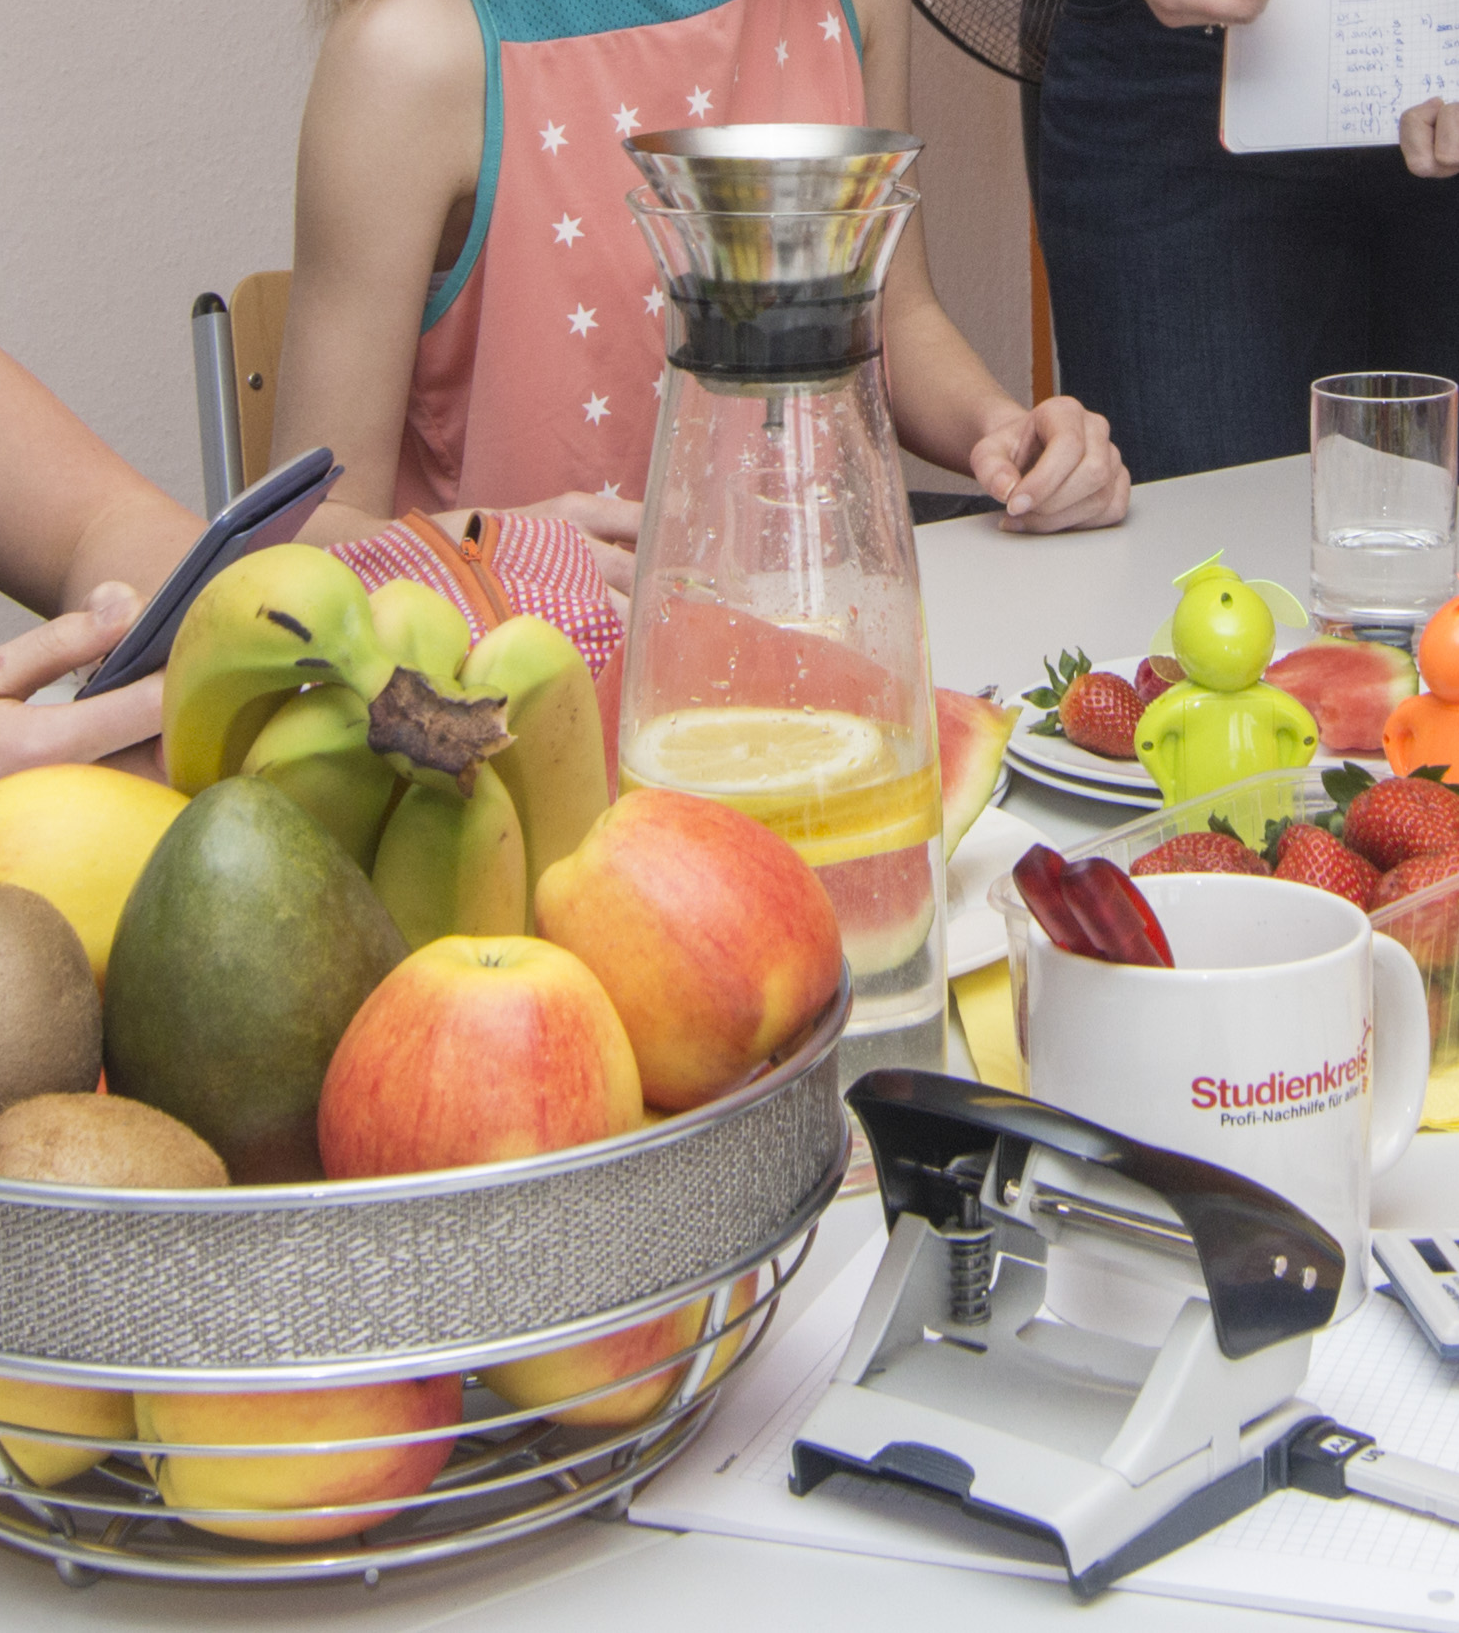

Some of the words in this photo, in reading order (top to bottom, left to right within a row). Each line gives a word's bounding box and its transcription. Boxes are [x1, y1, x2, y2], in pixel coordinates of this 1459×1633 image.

[1191, 1044, 1368, 1111] Studienkreis
[1220, 1099, 1326, 1128] Profi-Nachhilfe
[1328, 1093, 1342, 1111] für
